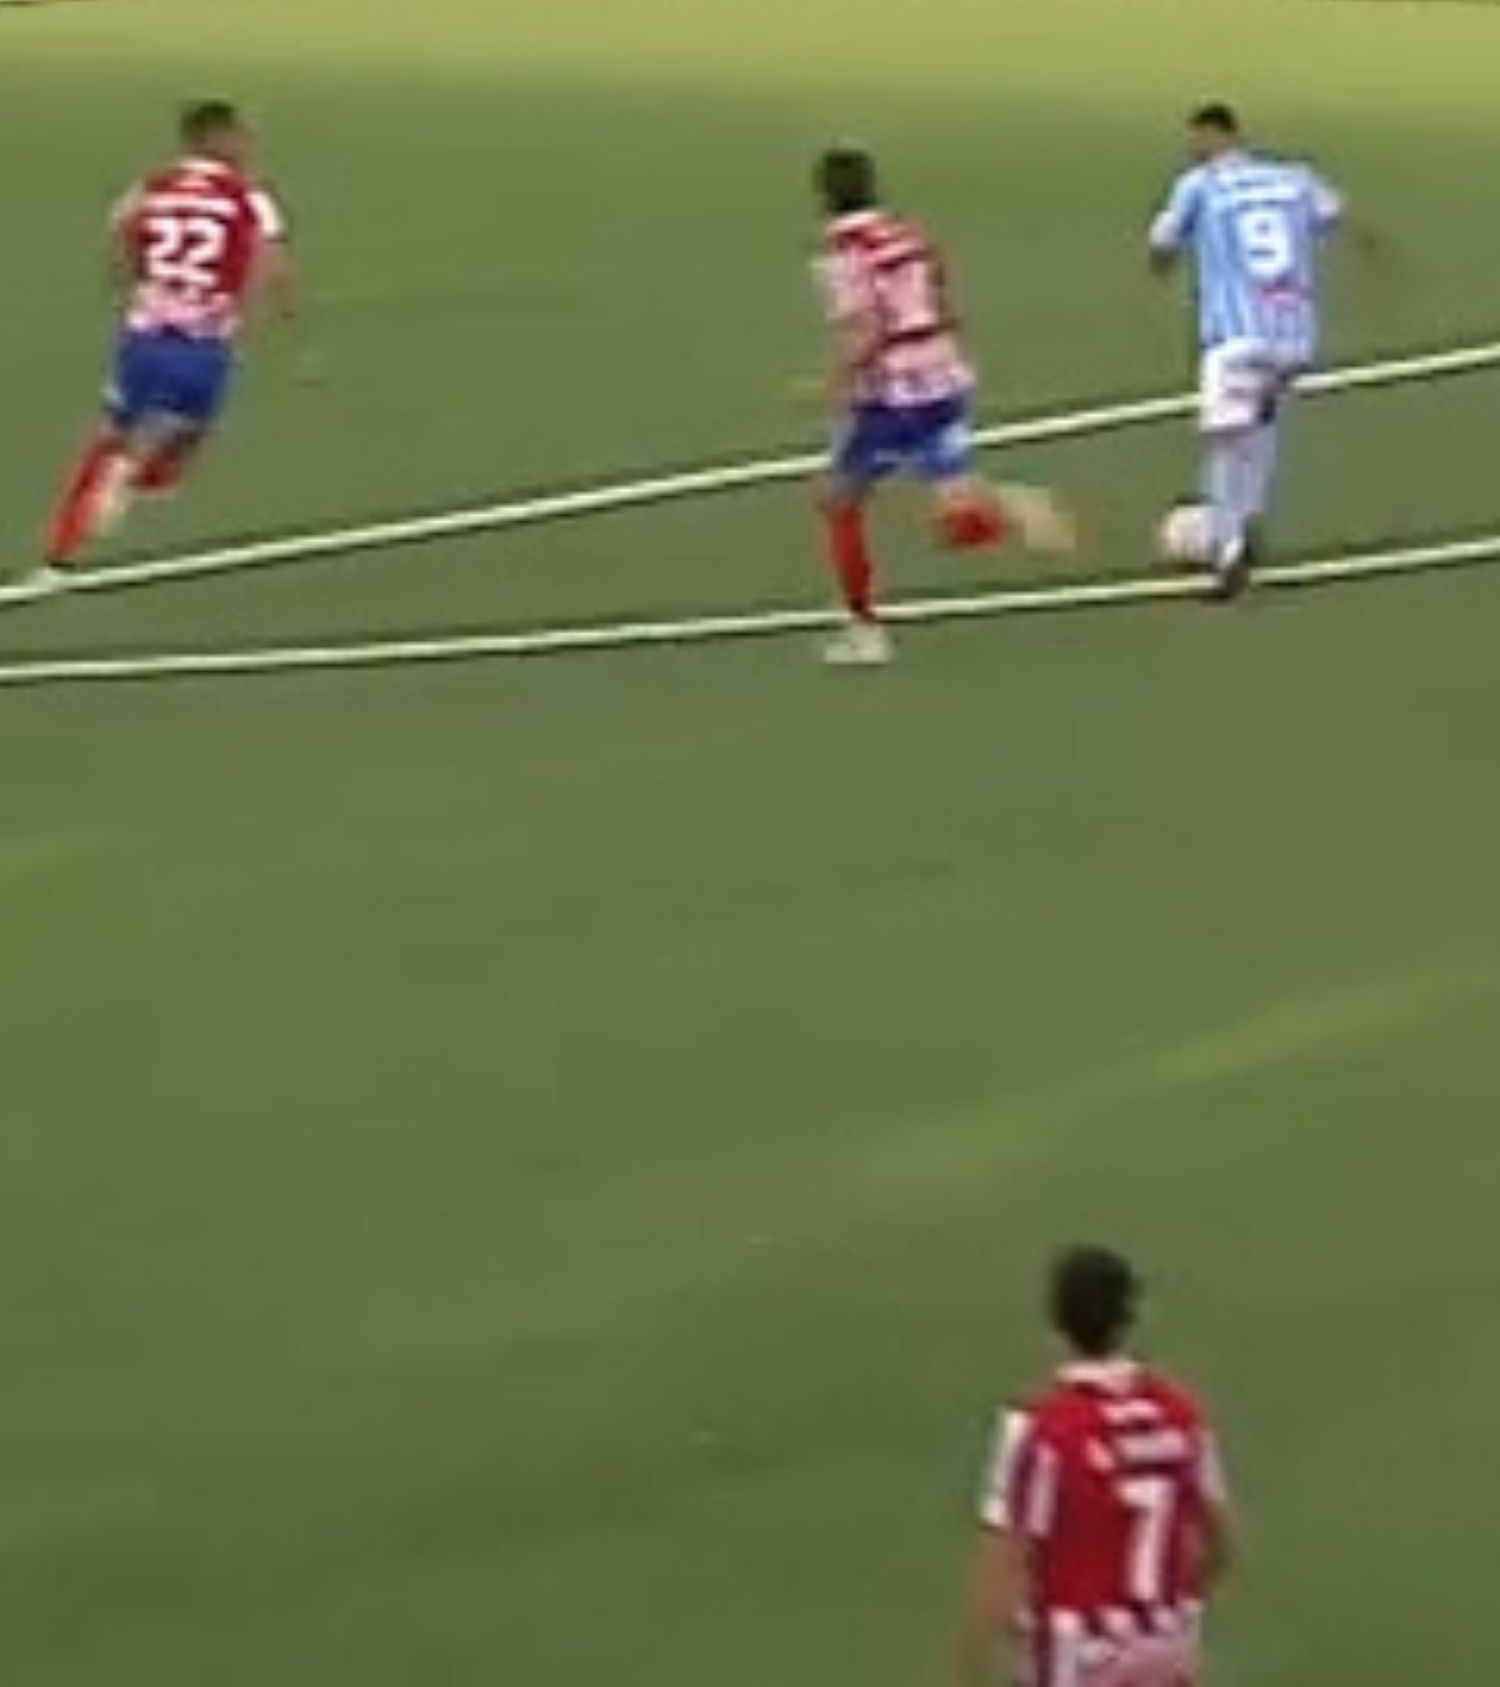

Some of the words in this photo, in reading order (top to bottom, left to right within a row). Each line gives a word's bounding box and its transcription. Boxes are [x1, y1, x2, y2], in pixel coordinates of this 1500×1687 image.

[146, 214, 227, 288] 22
[1235, 209, 1294, 278] 9
[1117, 1477, 1178, 1604] 7
